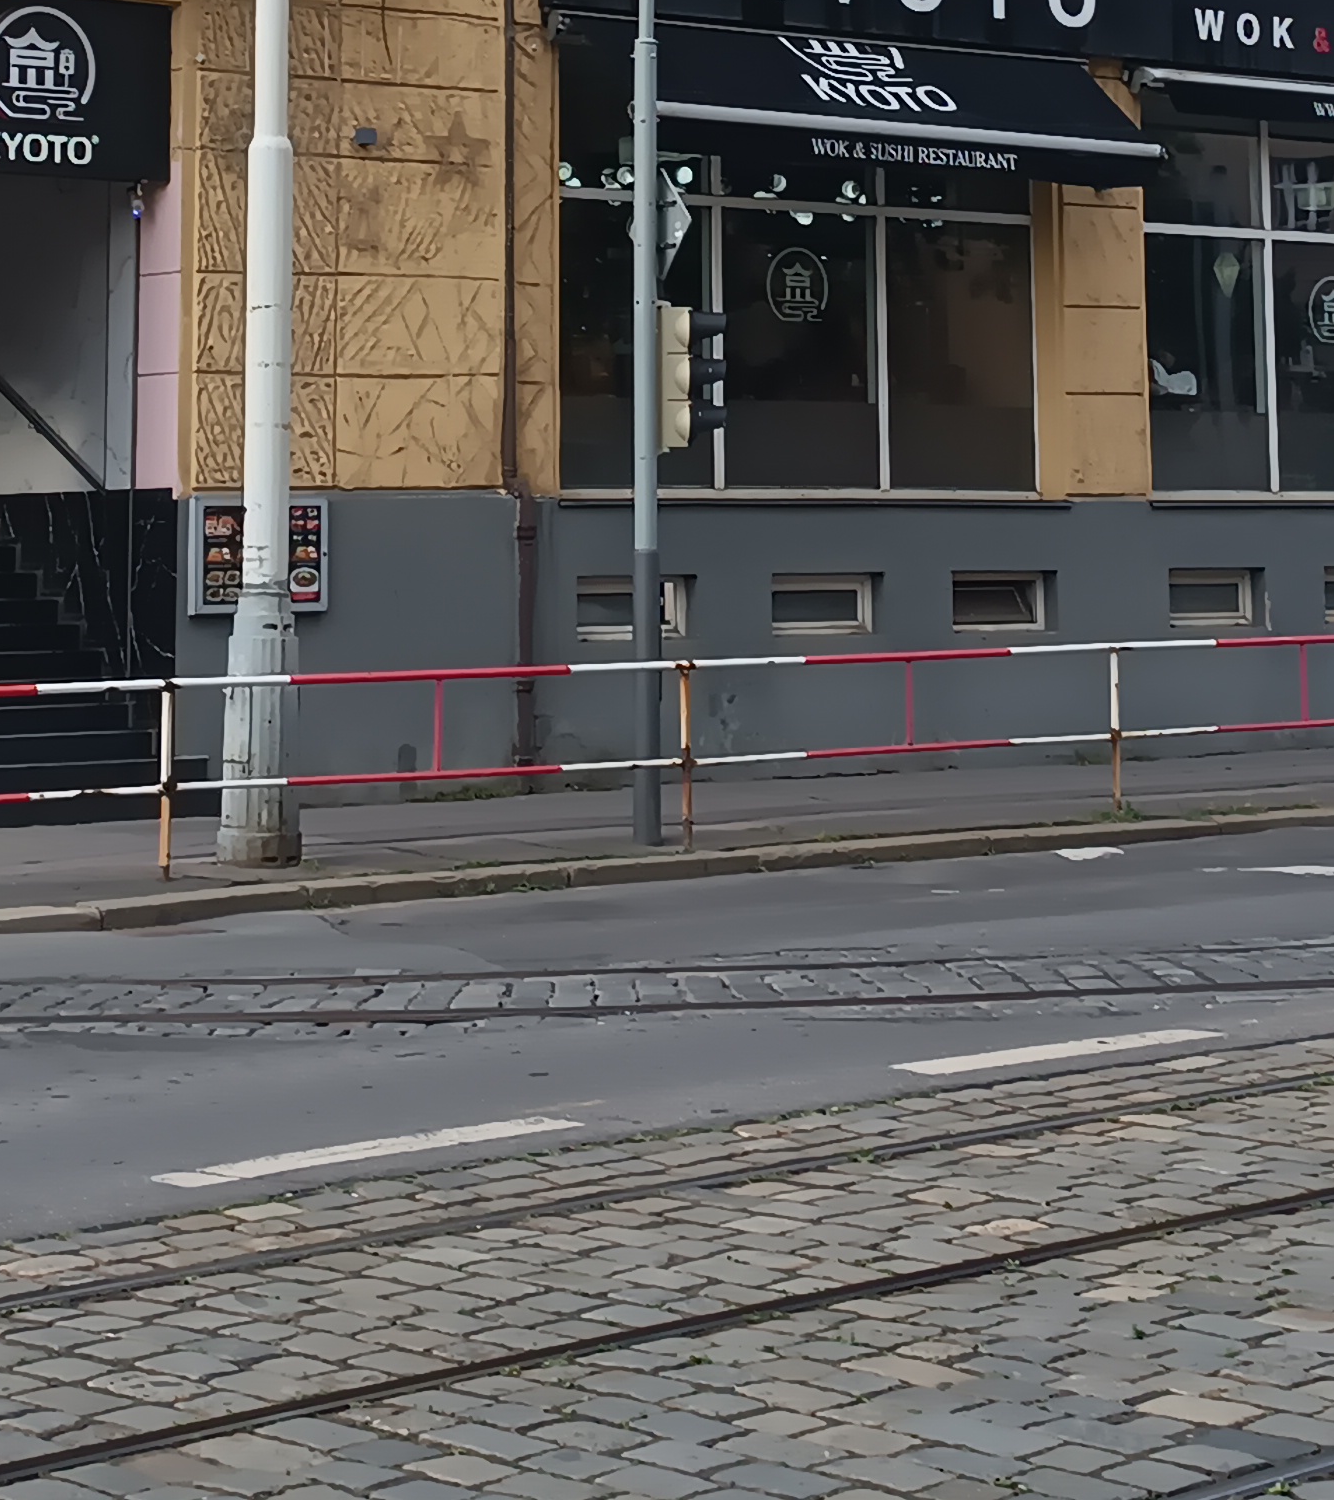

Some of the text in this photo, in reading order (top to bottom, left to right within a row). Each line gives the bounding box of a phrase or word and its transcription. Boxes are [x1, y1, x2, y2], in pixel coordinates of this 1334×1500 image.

[1194, 8, 1295, 49] WOK
[1312, 27, 1331, 52] &
[801, 74, 958, 112] KYOTO
[812, 138, 1019, 171] WOK & SUSHI RESTAURANT
